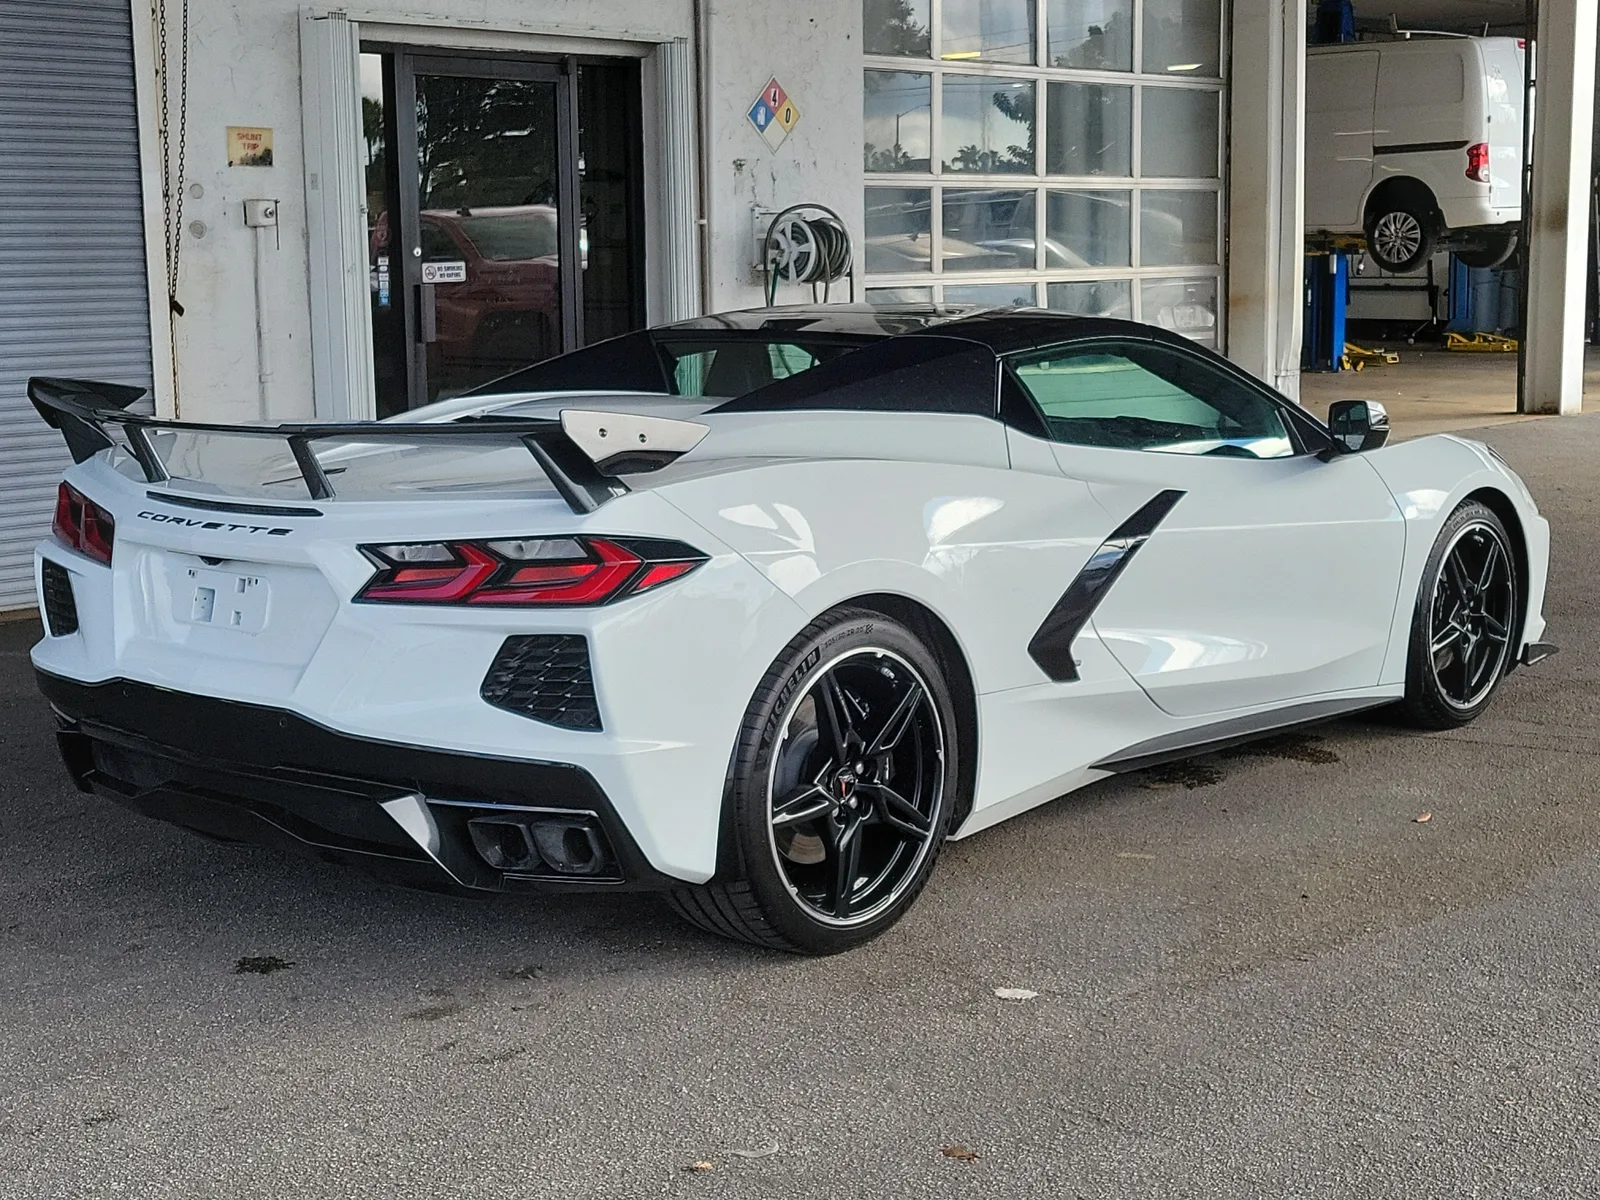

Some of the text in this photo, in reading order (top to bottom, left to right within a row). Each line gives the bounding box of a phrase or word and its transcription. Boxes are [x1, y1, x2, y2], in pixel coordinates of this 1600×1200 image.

[771, 89, 778, 106] 4
[784, 107, 792, 124] 0
[236, 132, 262, 141] SHUNT
[137, 511, 294, 536] CORVETTE
[763, 649, 819, 742] MICHELIN
